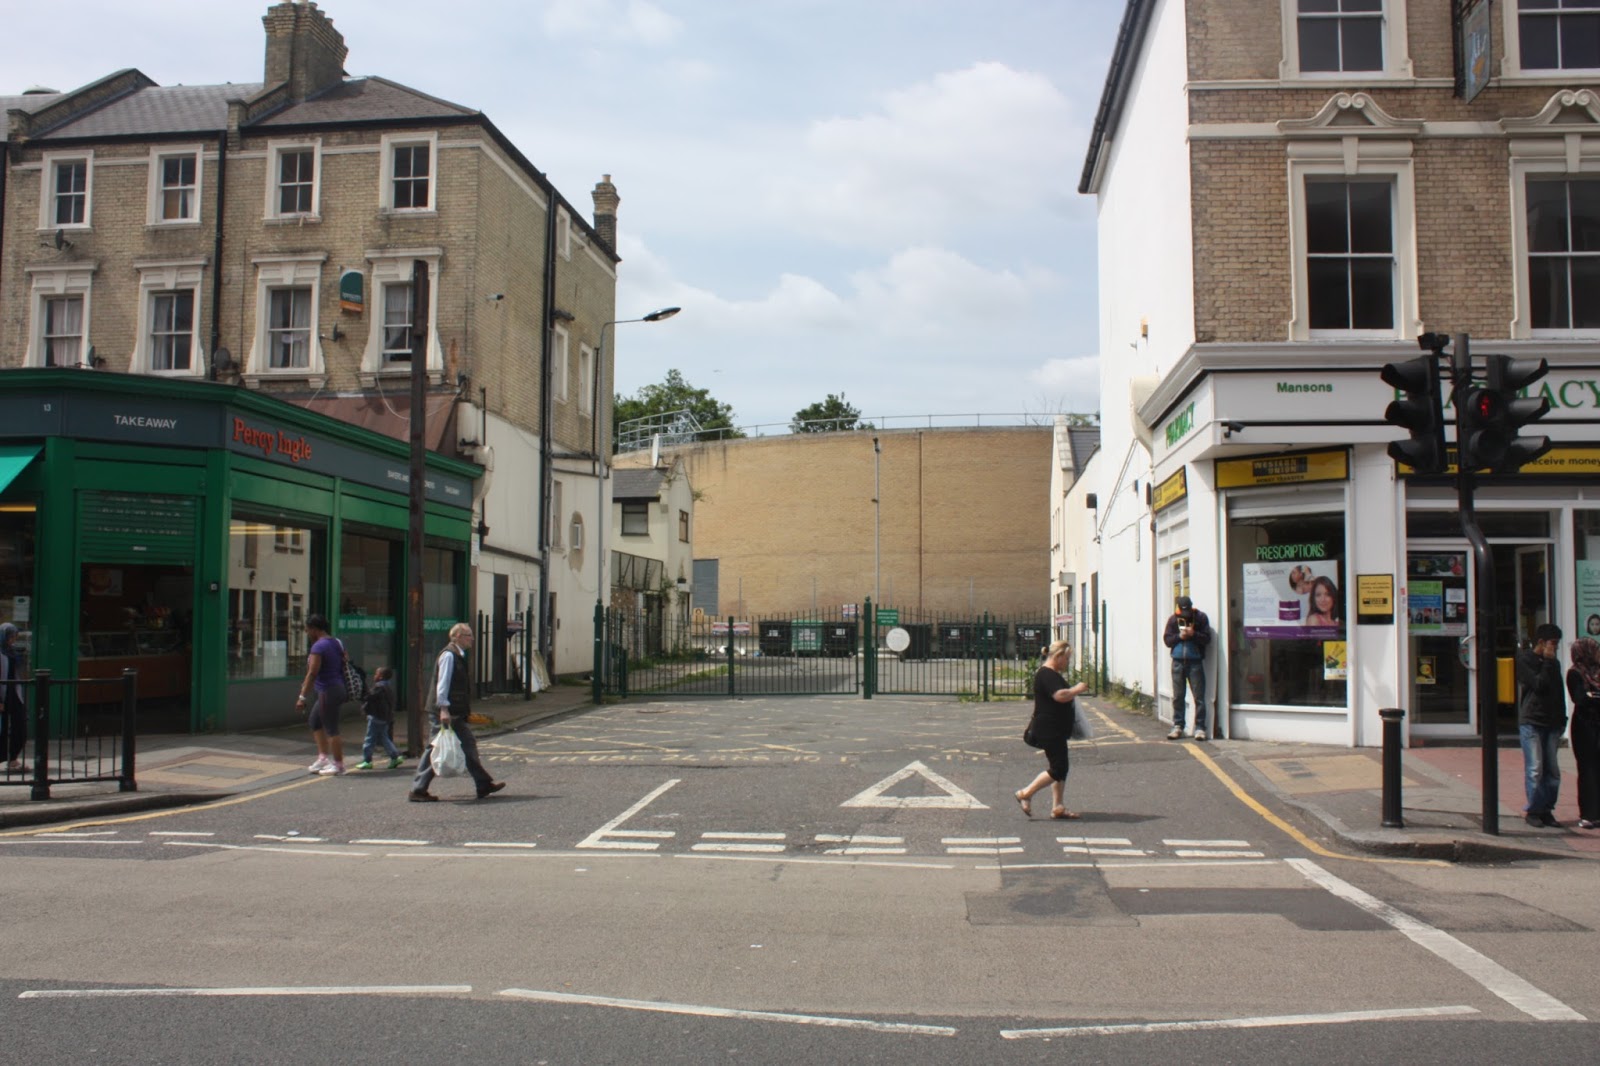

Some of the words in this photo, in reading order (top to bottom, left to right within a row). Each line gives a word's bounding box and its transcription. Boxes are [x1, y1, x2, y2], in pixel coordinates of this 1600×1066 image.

[1277, 382, 1333, 393] Mansons
[114, 415, 177, 429] TAKEAWAY
[233, 416, 275, 456] Percy
[277, 429, 313, 463] Ingle
[1254, 458, 1297, 469] WESTERN
[1268, 466, 1297, 475] UNION
[1256, 543, 1325, 560] PRESCRIPTIONS
